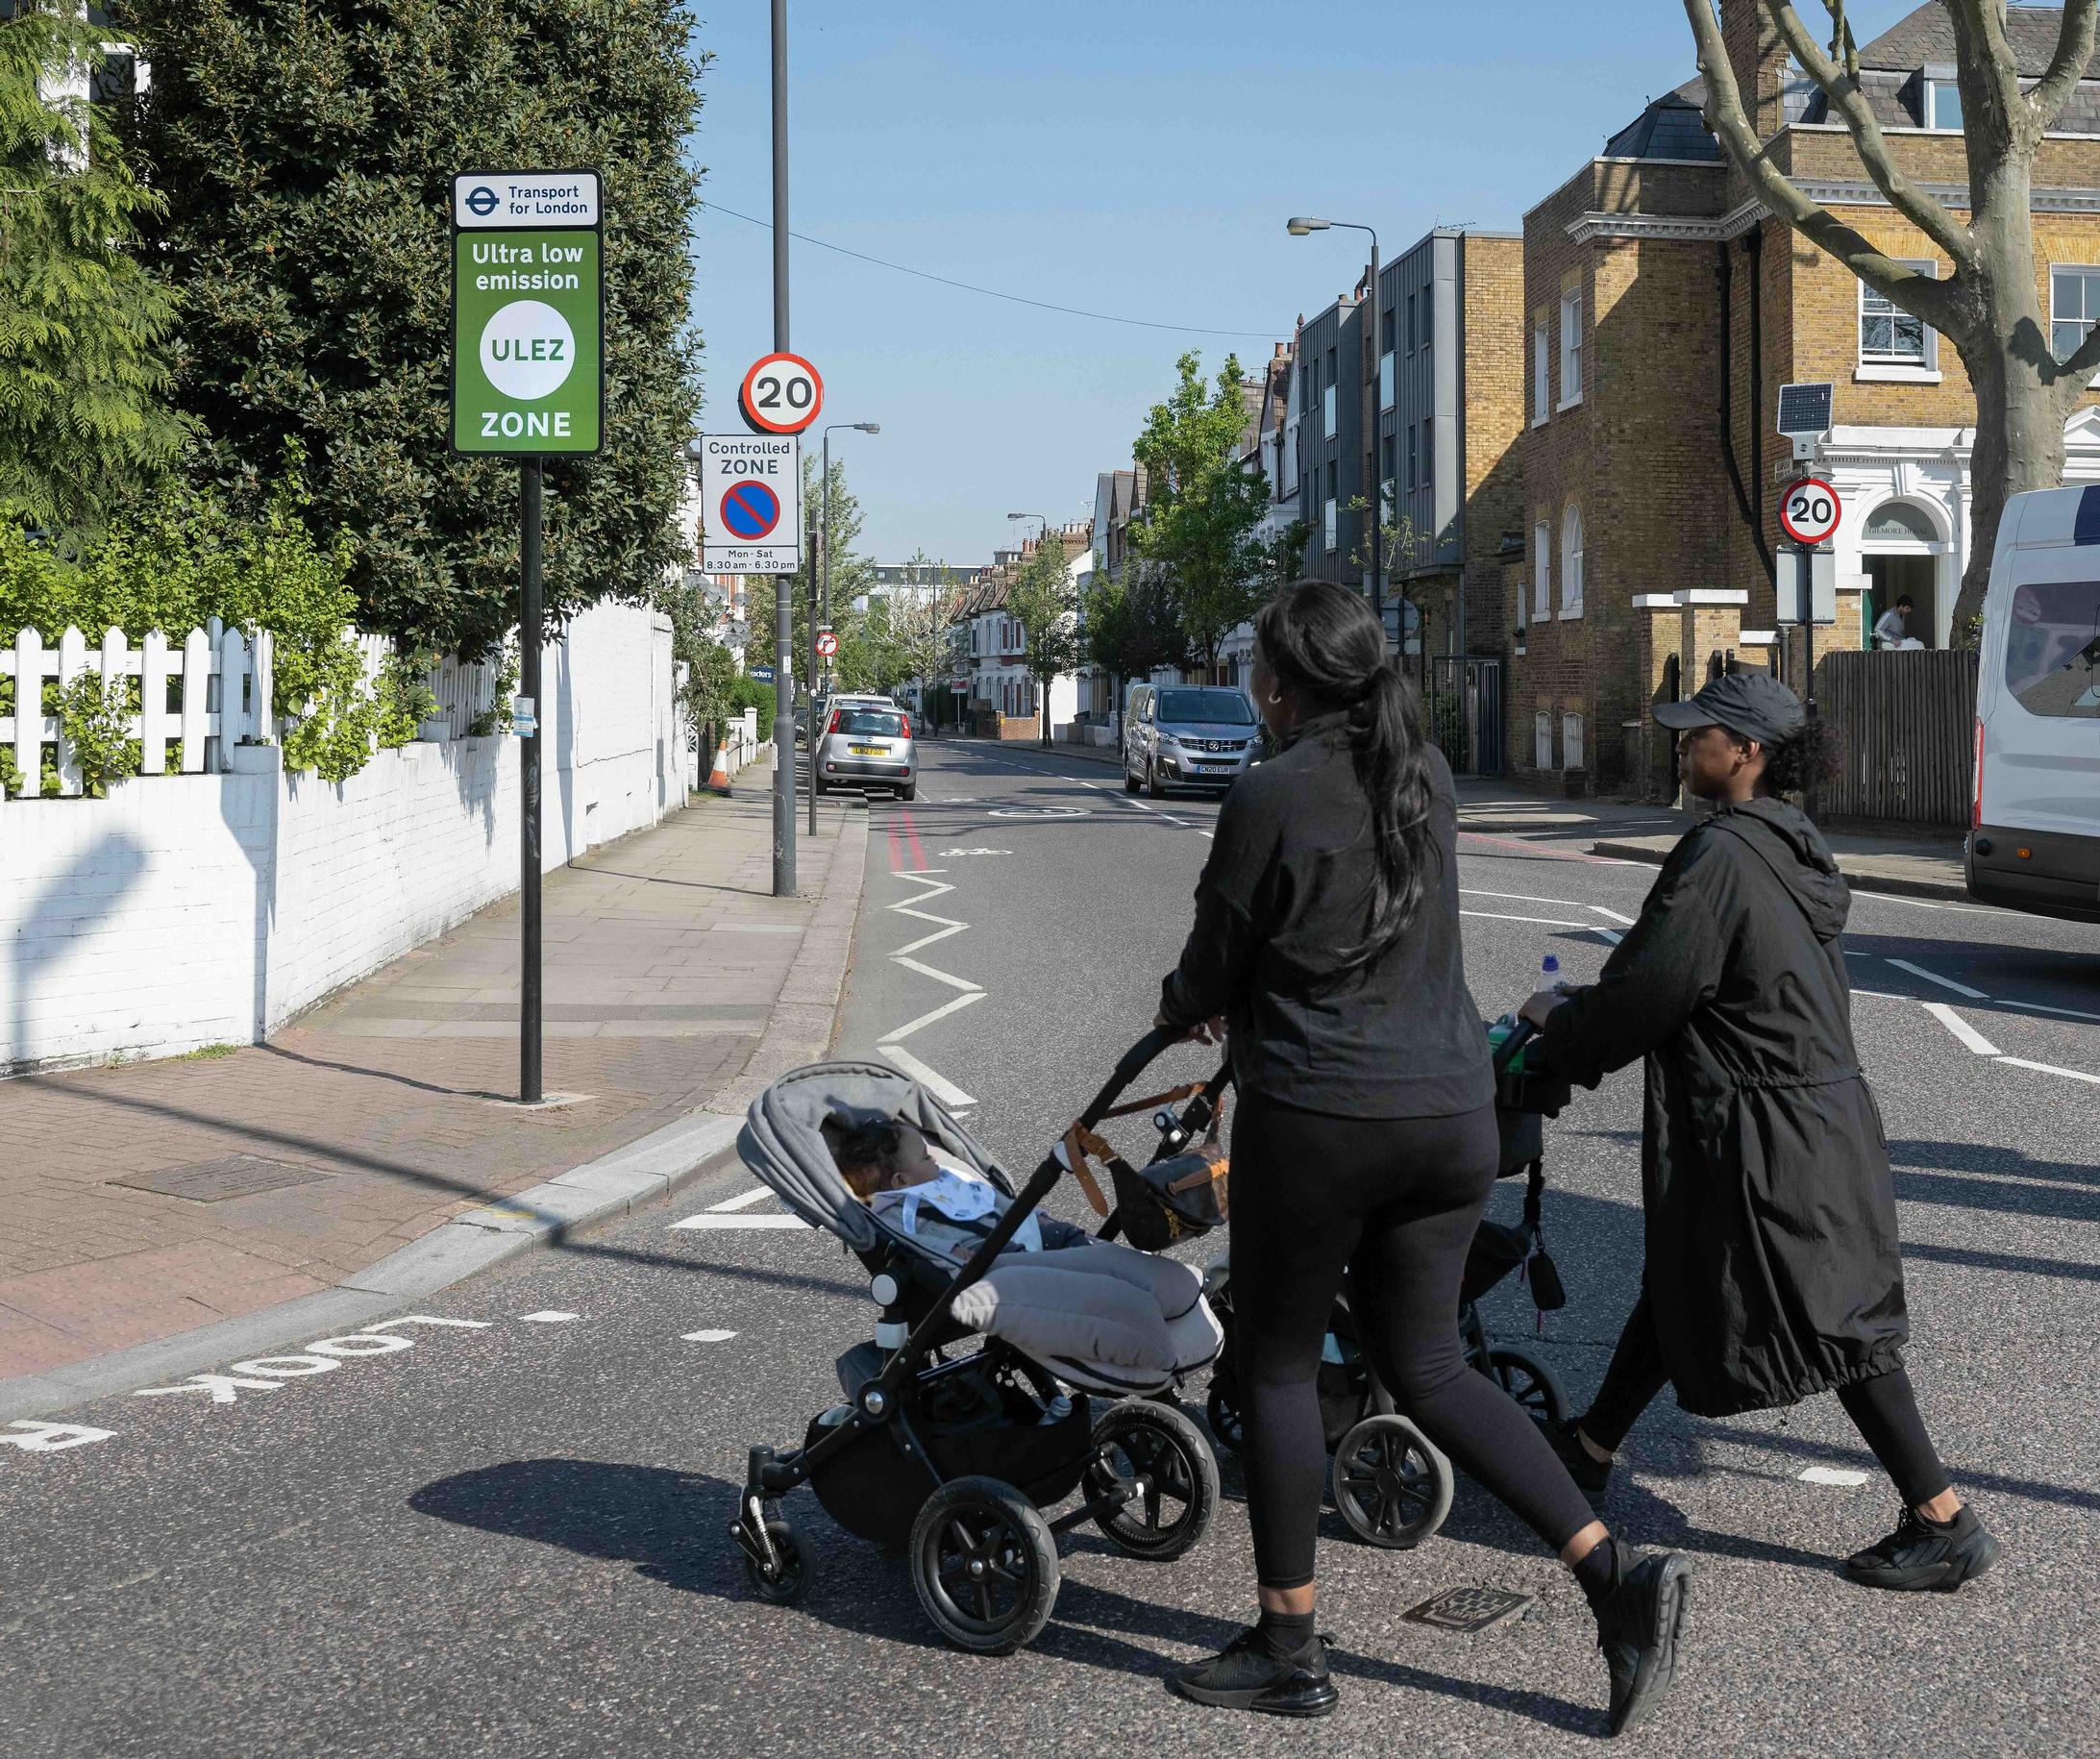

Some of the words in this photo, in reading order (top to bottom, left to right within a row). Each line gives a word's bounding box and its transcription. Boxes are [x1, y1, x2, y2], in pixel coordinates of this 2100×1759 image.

[508, 186, 579, 199] Transport
[509, 202, 530, 214] for
[535, 202, 588, 214] London
[473, 243, 532, 263] Ultra
[542, 243, 583, 263] low
[476, 270, 579, 290] emission
[492, 339, 564, 361] ULEZ
[756, 377, 813, 409] 20
[481, 412, 571, 437] ZONE
[709, 442, 790, 455] Controlled
[721, 459, 778, 474] ZONE
[1791, 496, 1832, 524] 20
[728, 550, 749, 558] Mon
[706, 560, 731, 569] 8.30
[754, 560, 778, 569] 6.30
[780, 562, 796, 571] pm
[133, 1315, 494, 1403] LOOK
